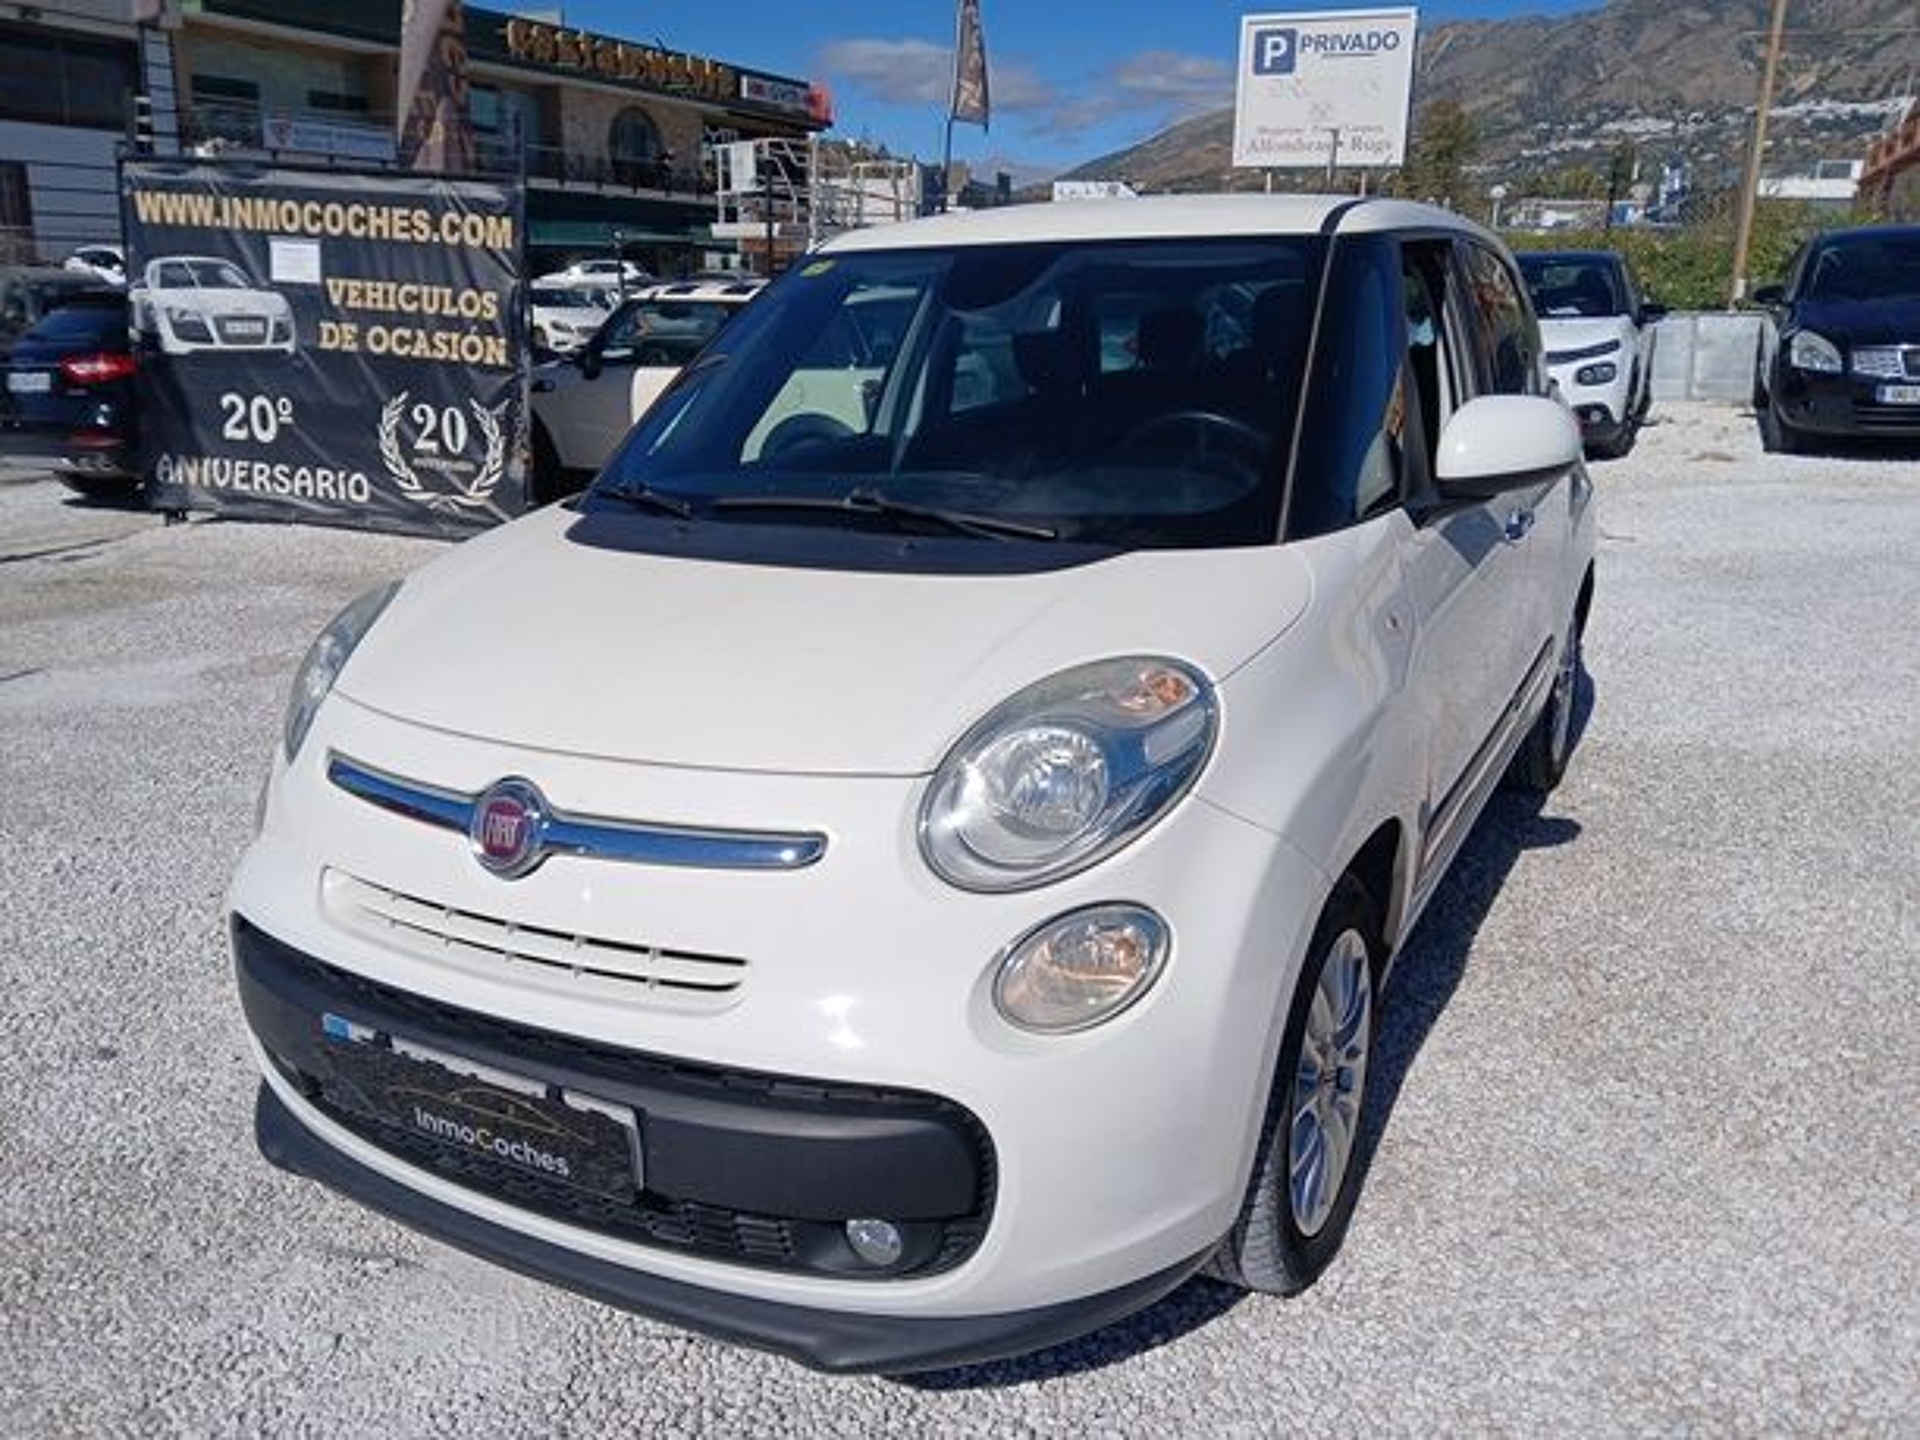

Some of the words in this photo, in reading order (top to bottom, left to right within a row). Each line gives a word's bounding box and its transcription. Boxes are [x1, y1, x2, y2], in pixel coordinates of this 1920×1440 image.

[1263, 36, 1288, 69] P
[1300, 30, 1400, 54] PRIVADO
[134, 189, 513, 250] WWW.INMOCOCHES.COM
[326, 278, 499, 320] VEHICULOS
[319, 321, 359, 352] DE
[366, 325, 507, 365] OCASIÓN
[412, 402, 469, 455] 20
[155, 452, 370, 503] ANIVERSARIO
[486, 811, 521, 848] FIAT
[413, 1106, 571, 1178] InmoCoches
